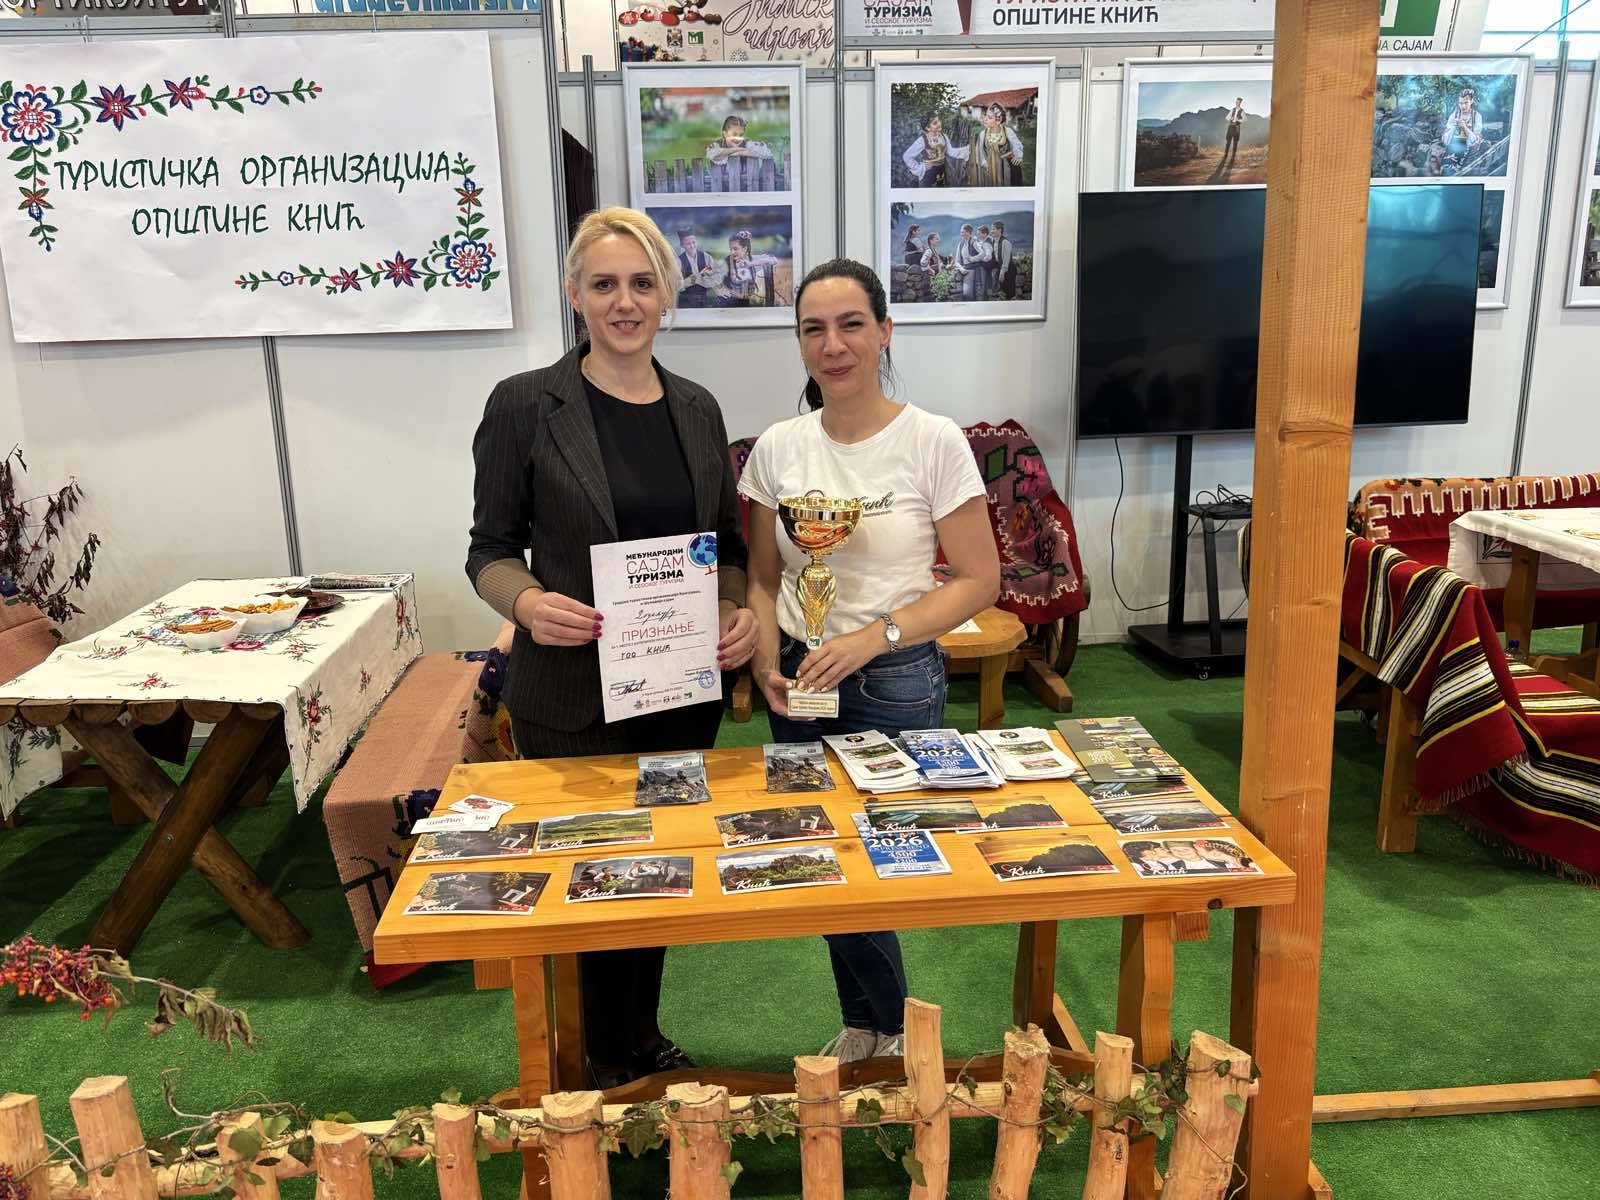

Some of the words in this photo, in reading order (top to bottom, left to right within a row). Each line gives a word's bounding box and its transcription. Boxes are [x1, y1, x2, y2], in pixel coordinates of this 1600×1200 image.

[864, 6, 932, 18] ТУРИЗМА
[992, 8, 1095, 25] ОПШТИНЕ
[1100, 6, 1159, 24] КНИЋ
[1393, 40, 1433, 51] САЈАМ
[53, 156, 220, 191] ТУРИСТИЧКА
[240, 151, 451, 193] ОРГАНИЗАЦИЈА
[131, 204, 269, 239] ОПШТИНЕ
[287, 203, 366, 232] КНИЋ
[626, 548, 684, 560] МЕЂУНАРОДНИ
[626, 555, 684, 575] САЈАМ
[628, 569, 684, 585] ТУРИЗМА
[621, 620, 695, 642] ПРИЗНАЊЕ
[915, 749, 964, 757] 2026
[867, 836, 923, 848] 2026
